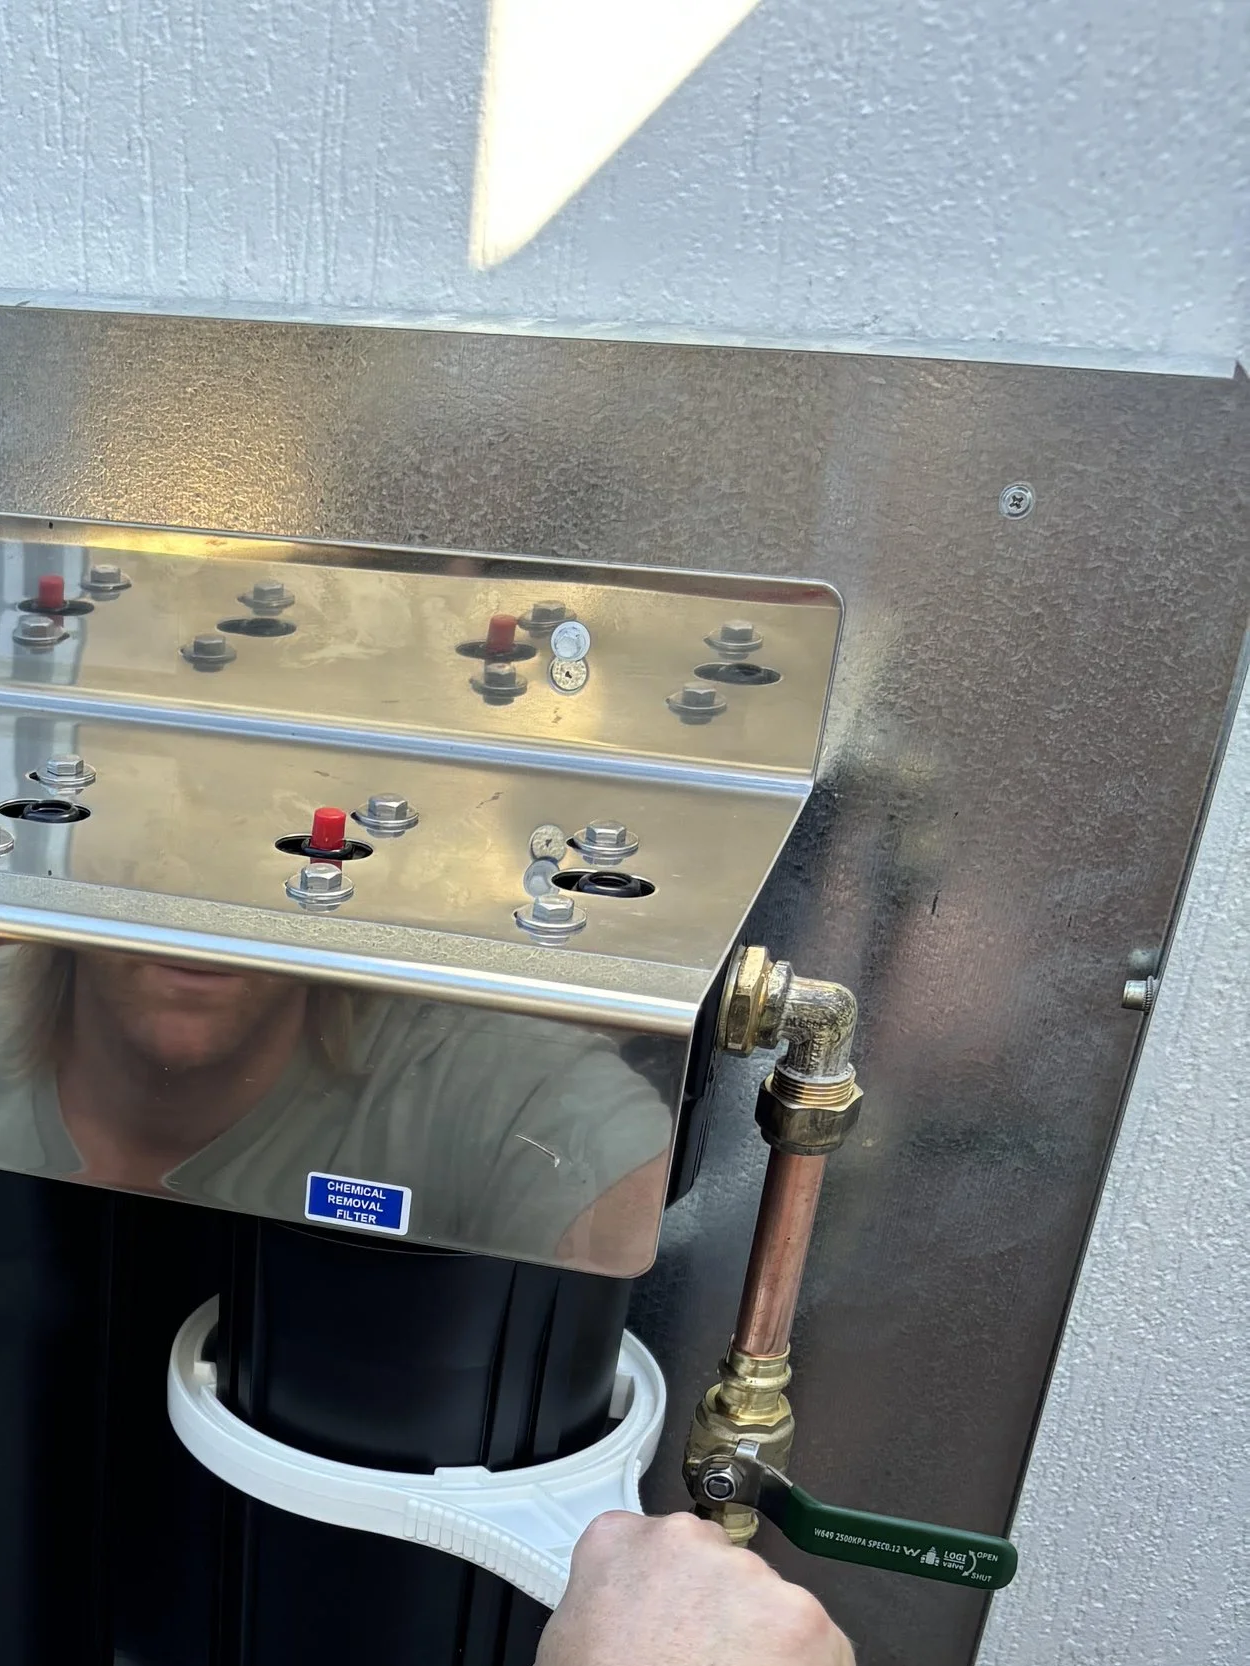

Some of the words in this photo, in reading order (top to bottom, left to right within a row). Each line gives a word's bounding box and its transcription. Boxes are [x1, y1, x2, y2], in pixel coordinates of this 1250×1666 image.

[327, 1181, 387, 1200] CHEMICAL
[327, 1194, 384, 1212] REMOVAL
[336, 1209, 377, 1224] FILTER
[814, 1528, 834, 1540] W649
[835, 1532, 866, 1547] 2500KPA
[943, 1550, 967, 1563] LOGI
[976, 1551, 999, 1562] OPEN
[942, 1560, 964, 1571] valve
[970, 1571, 992, 1583] SHUT
